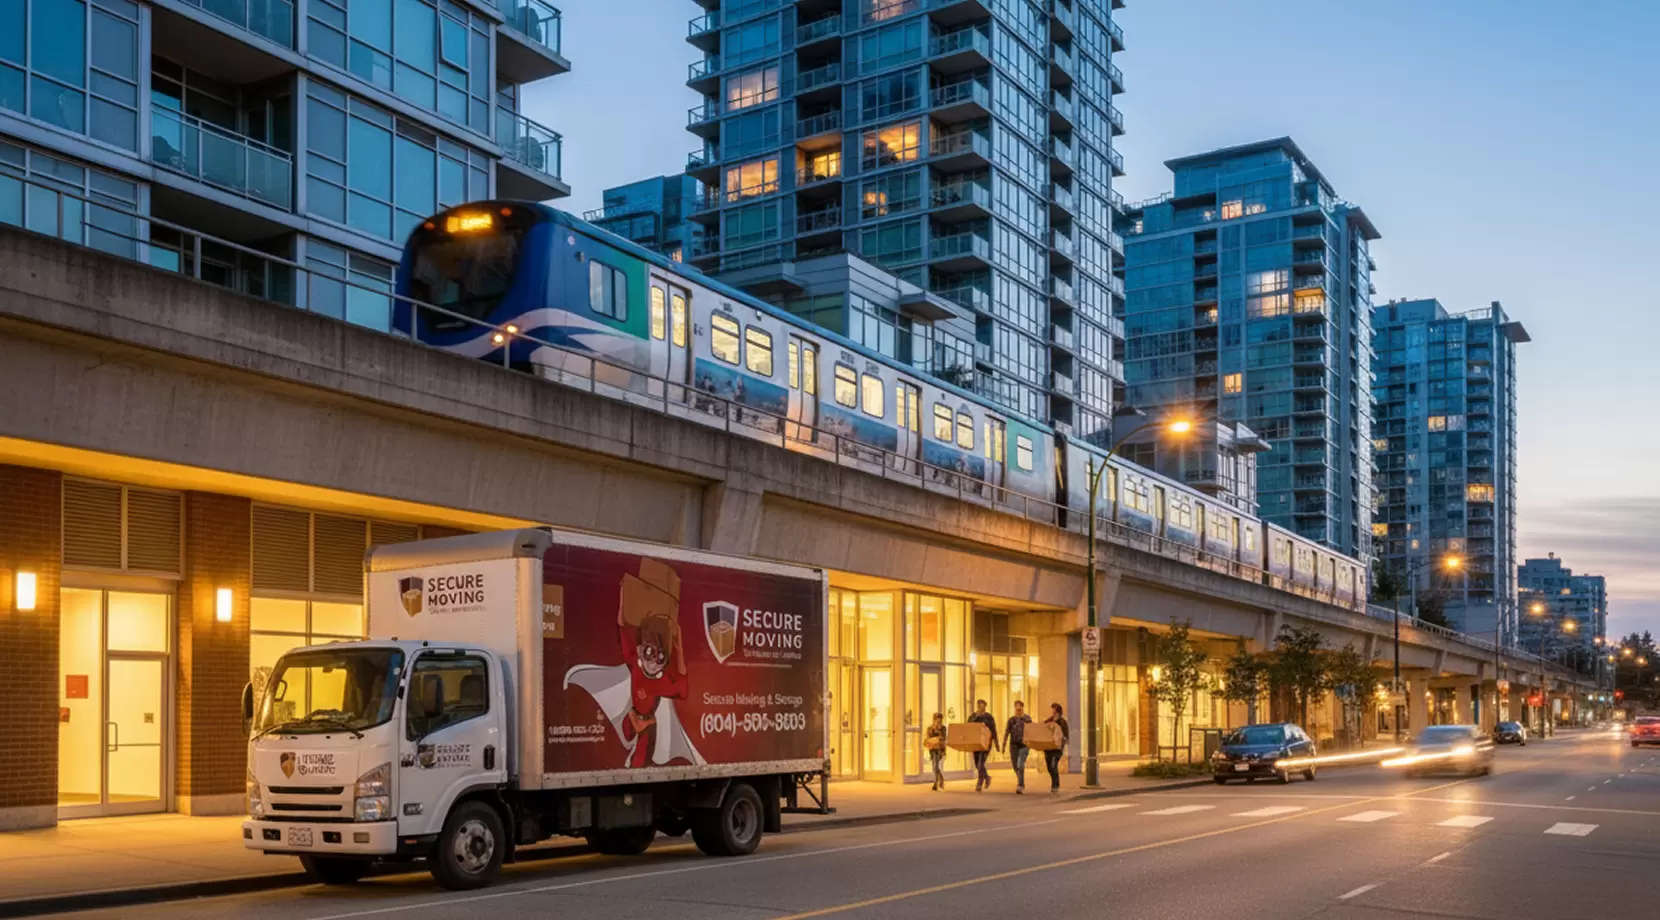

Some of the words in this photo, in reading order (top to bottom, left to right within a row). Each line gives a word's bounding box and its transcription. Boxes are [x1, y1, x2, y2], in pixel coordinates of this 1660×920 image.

[428, 574, 484, 592] SECURE
[428, 590, 484, 606] MOVING
[743, 609, 802, 631] SECURE
[743, 632, 802, 649] MOVING
